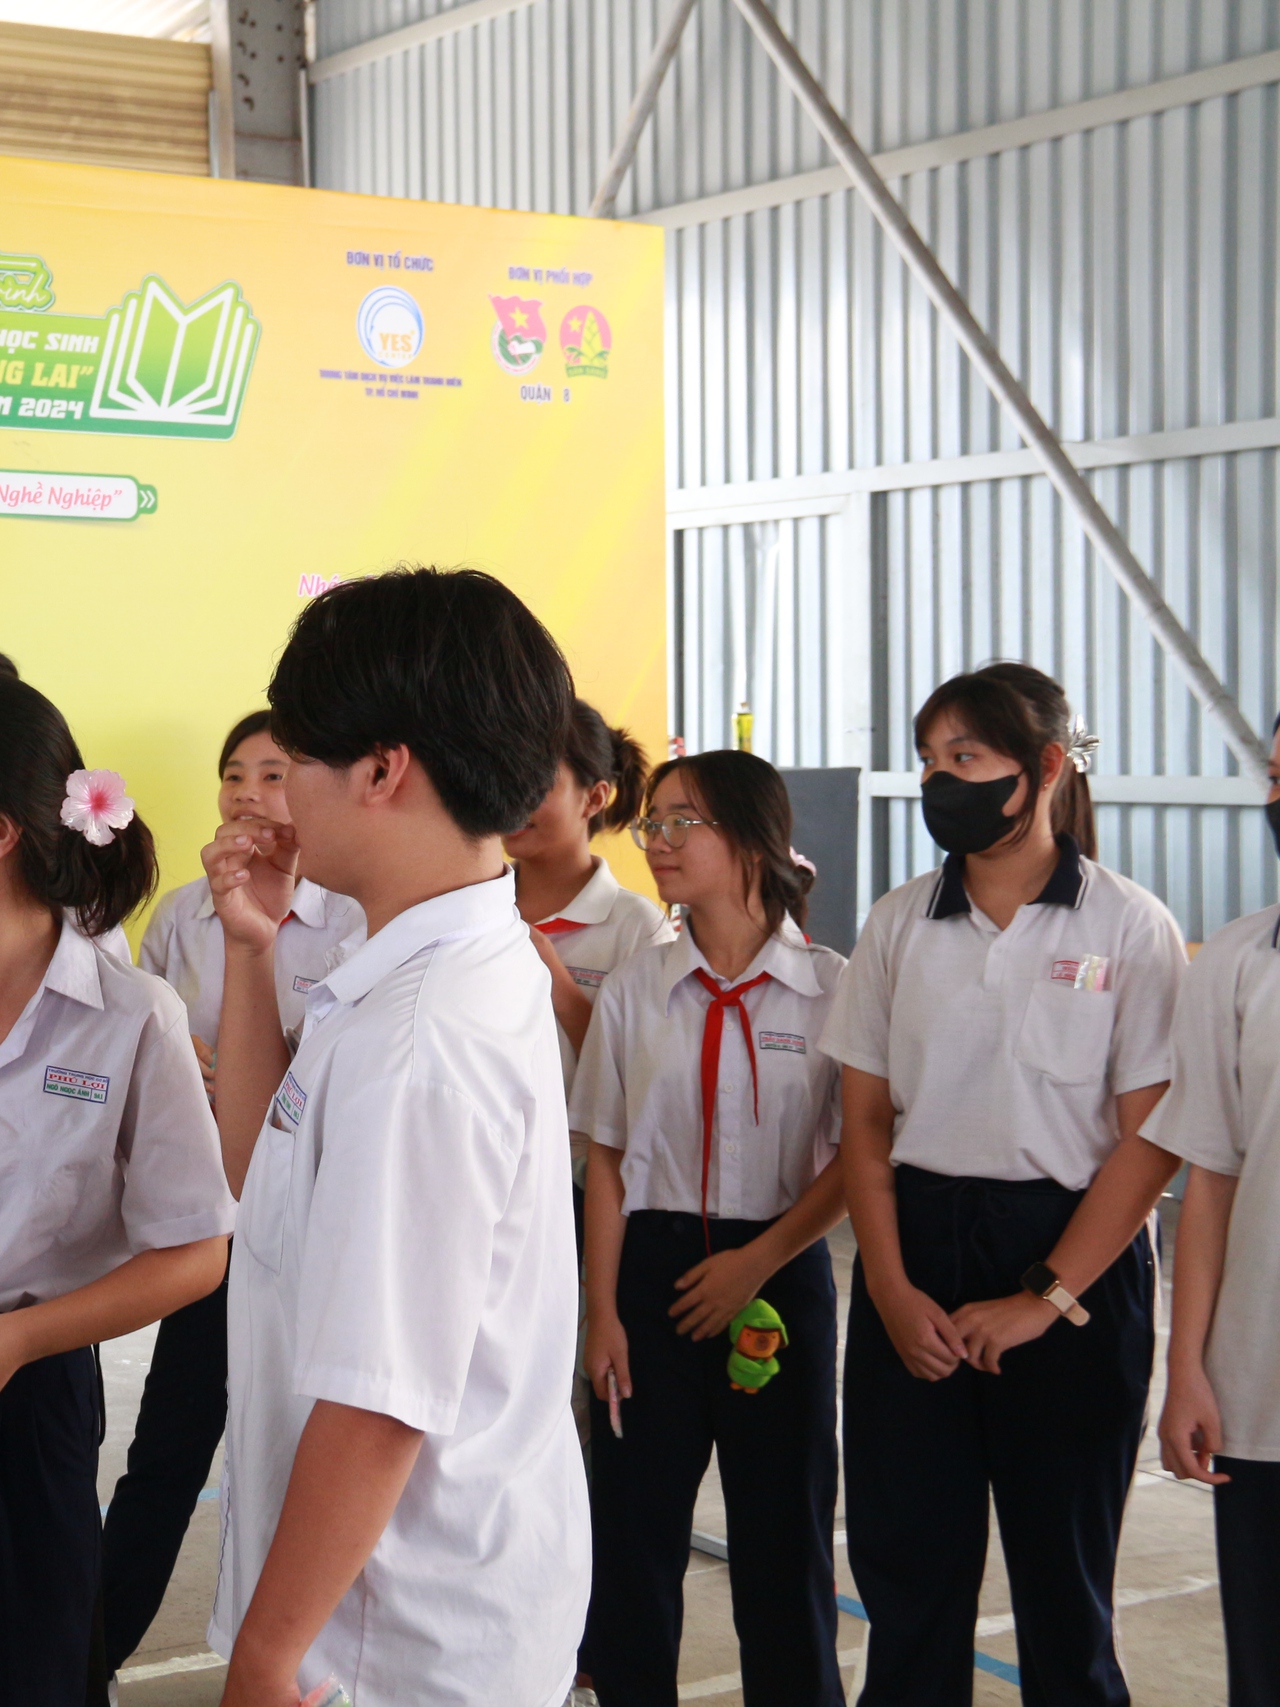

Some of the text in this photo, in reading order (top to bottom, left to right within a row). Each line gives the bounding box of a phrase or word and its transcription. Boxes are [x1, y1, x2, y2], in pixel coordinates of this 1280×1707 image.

[404, 255, 434, 272] CHỨC
[44, 332, 100, 354] SINH
[379, 332, 412, 352] YES
[30, 361, 95, 389] LAI”
[520, 383, 551, 403] QUẬN
[18, 398, 85, 420] 2024
